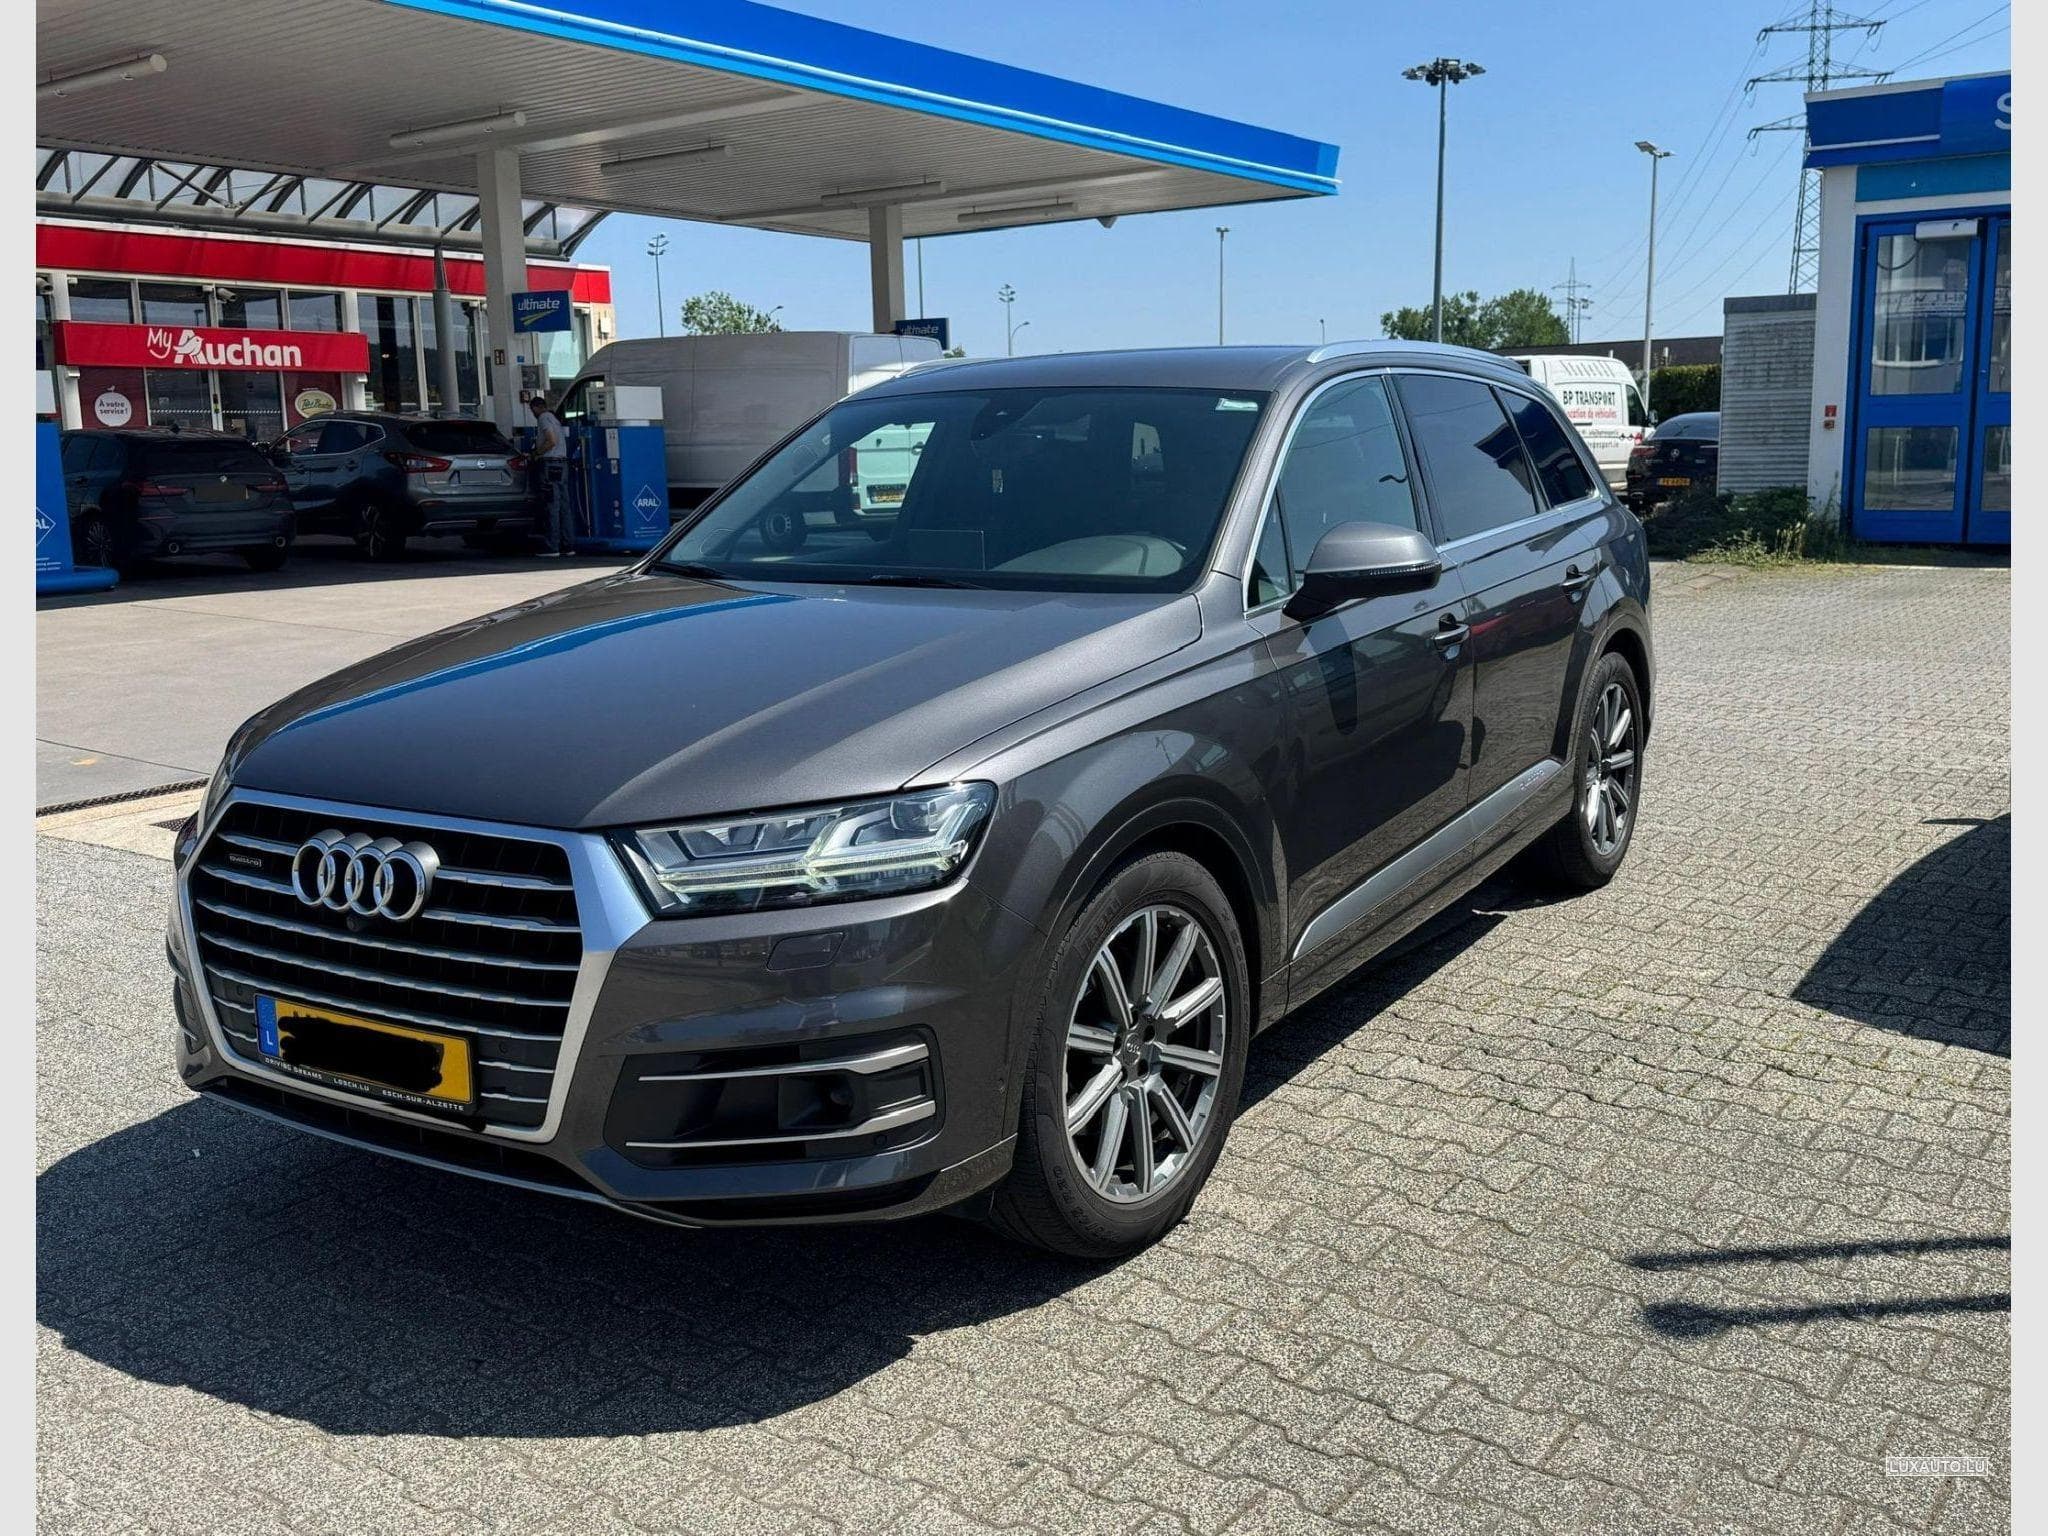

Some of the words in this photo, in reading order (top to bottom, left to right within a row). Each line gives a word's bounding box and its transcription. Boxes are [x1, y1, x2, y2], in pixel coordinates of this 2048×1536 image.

[517, 298, 560, 311] ultimate
[147, 328, 173, 359] My
[173, 329, 302, 367] Auchan
[1563, 391, 1573, 405] BP
[1575, 391, 1615, 406] TRANSPORT
[637, 498, 658, 507] ARAL
[266, 1031, 274, 1046] L
[265, 1057, 292, 1071] DRIVING
[293, 1066, 322, 1080] DREAMS
[333, 1077, 370, 1091] LOSCH.LU
[382, 1089, 465, 1112] ESCH-SUR-ALZETTE
